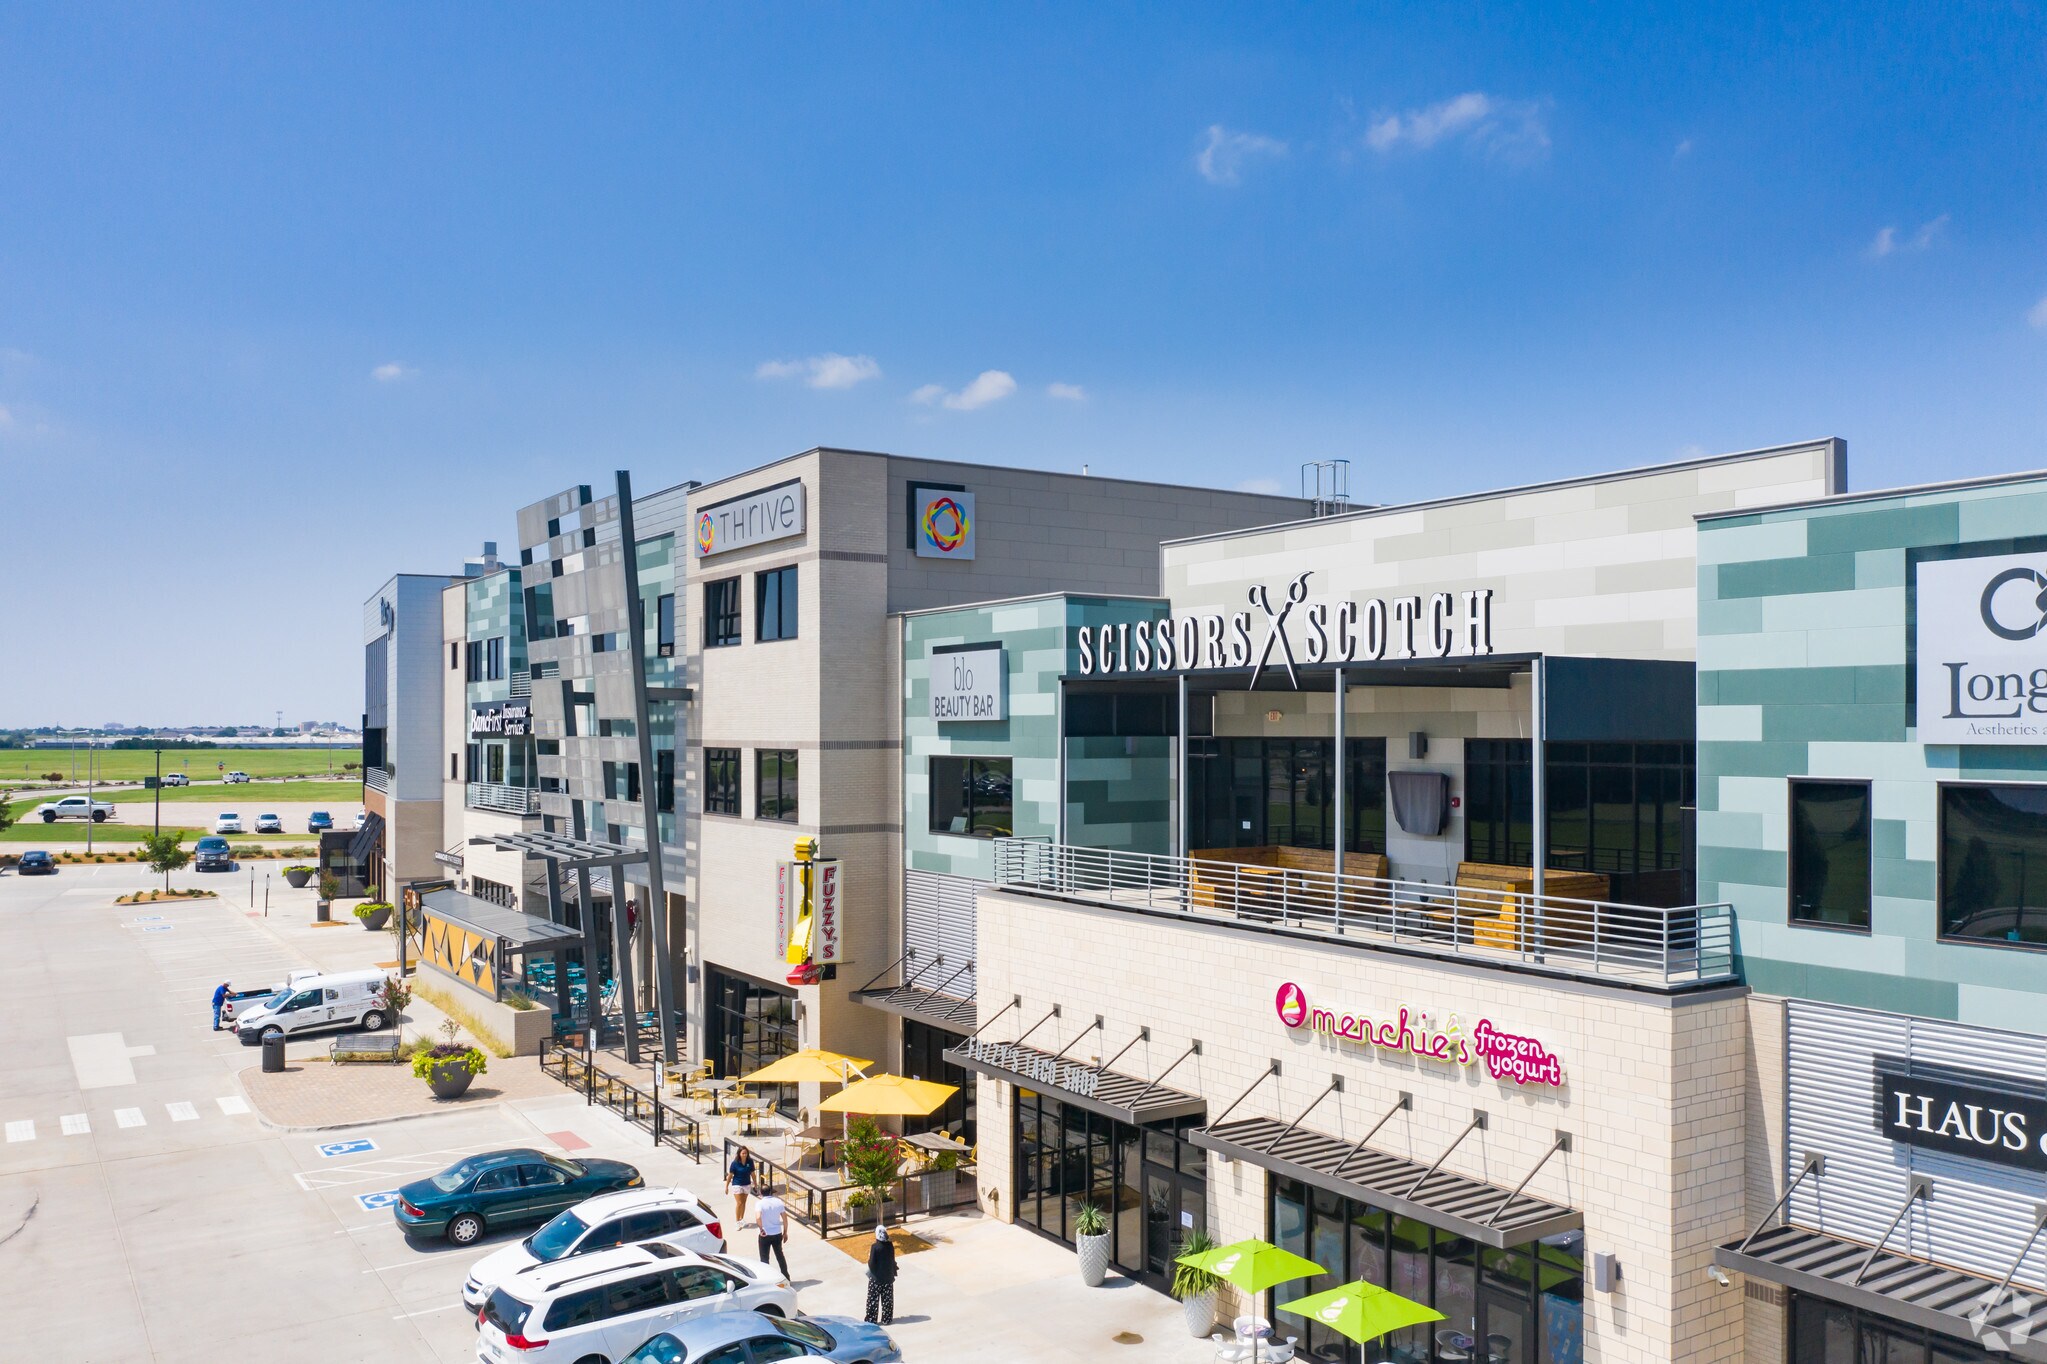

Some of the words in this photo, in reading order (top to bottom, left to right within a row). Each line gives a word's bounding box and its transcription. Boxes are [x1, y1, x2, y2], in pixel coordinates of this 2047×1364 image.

[1078, 612, 1252, 675] SCISSORS
[1304, 589, 1493, 663] SCOTCH
[953, 656, 974, 691] blo
[472, 708, 502, 732] BancFirst
[502, 703, 527, 719] Insurance
[934, 695, 971, 717] BEAUTY
[973, 694, 994, 716] BAR
[504, 719, 525, 736] Services
[1966, 722, 2038, 736] Aesthetics
[821, 865, 838, 960] FUZZY'S
[1311, 1003, 1470, 1065] menchie's
[1476, 1023, 1543, 1060] frozen
[968, 1036, 1020, 1073] FUZZY'S
[1025, 1053, 1057, 1085] TACO
[1063, 1065, 1098, 1098] SHOP
[1489, 1051, 1559, 1083] yogurt
[1893, 1091, 2028, 1151] HAUS
